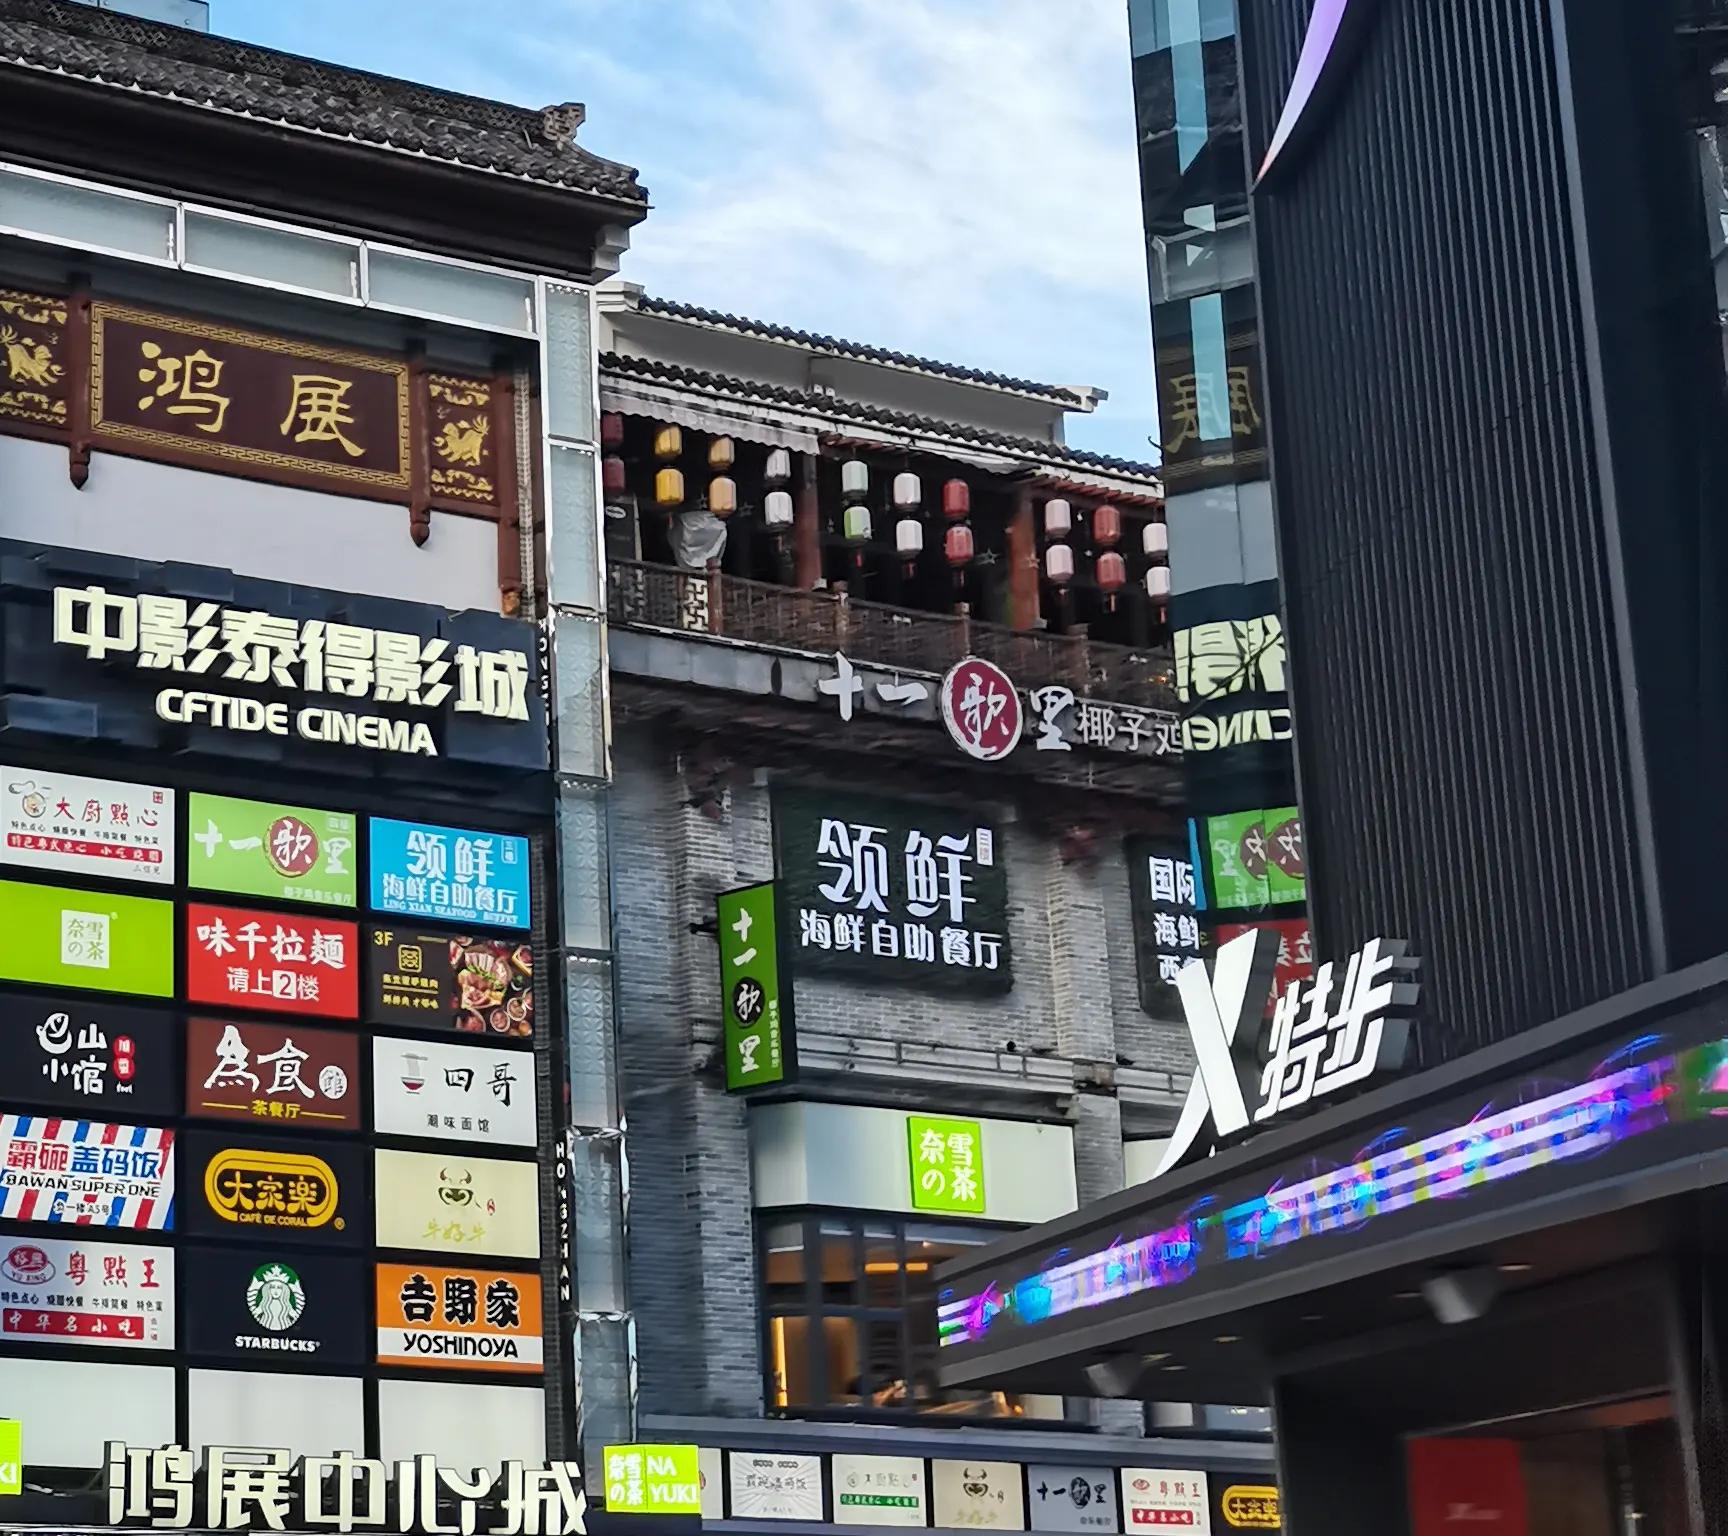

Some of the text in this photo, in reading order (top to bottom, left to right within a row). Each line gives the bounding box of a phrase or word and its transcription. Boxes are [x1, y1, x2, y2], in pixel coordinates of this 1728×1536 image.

[137, 340, 365, 458] 鸿展
[52, 585, 531, 723] 中影泰得影城
[155, 687, 439, 757] CFTIDE CINEMA
[819, 650, 1076, 752] 十一歌里
[193, 817, 353, 875] 十一歌里
[406, 830, 496, 886] 领鲜
[817, 817, 978, 924] 领鲜
[382, 872, 519, 915] 海鲜自助餐厅
[373, 929, 394, 947] 3F
[799, 908, 1003, 971] 海鲜自助餐厅
[227, 966, 320, 1002] 请上2楼
[443, 1062, 518, 1108] 四哥
[251, 1099, 301, 1120] 茶餐厅
[918, 1128, 975, 1166] 奈雪
[5, 1174, 161, 1198] BAWAN SUPER ONE
[922, 1164, 978, 1201] の茶
[235, 1335, 320, 1353] STARBUCKS
[403, 1332, 519, 1359] YOSHINOYA
[646, 1455, 677, 1476] NA
[107, 1441, 589, 1536] 鸿展中心城
[650, 1483, 697, 1504] YUKI
